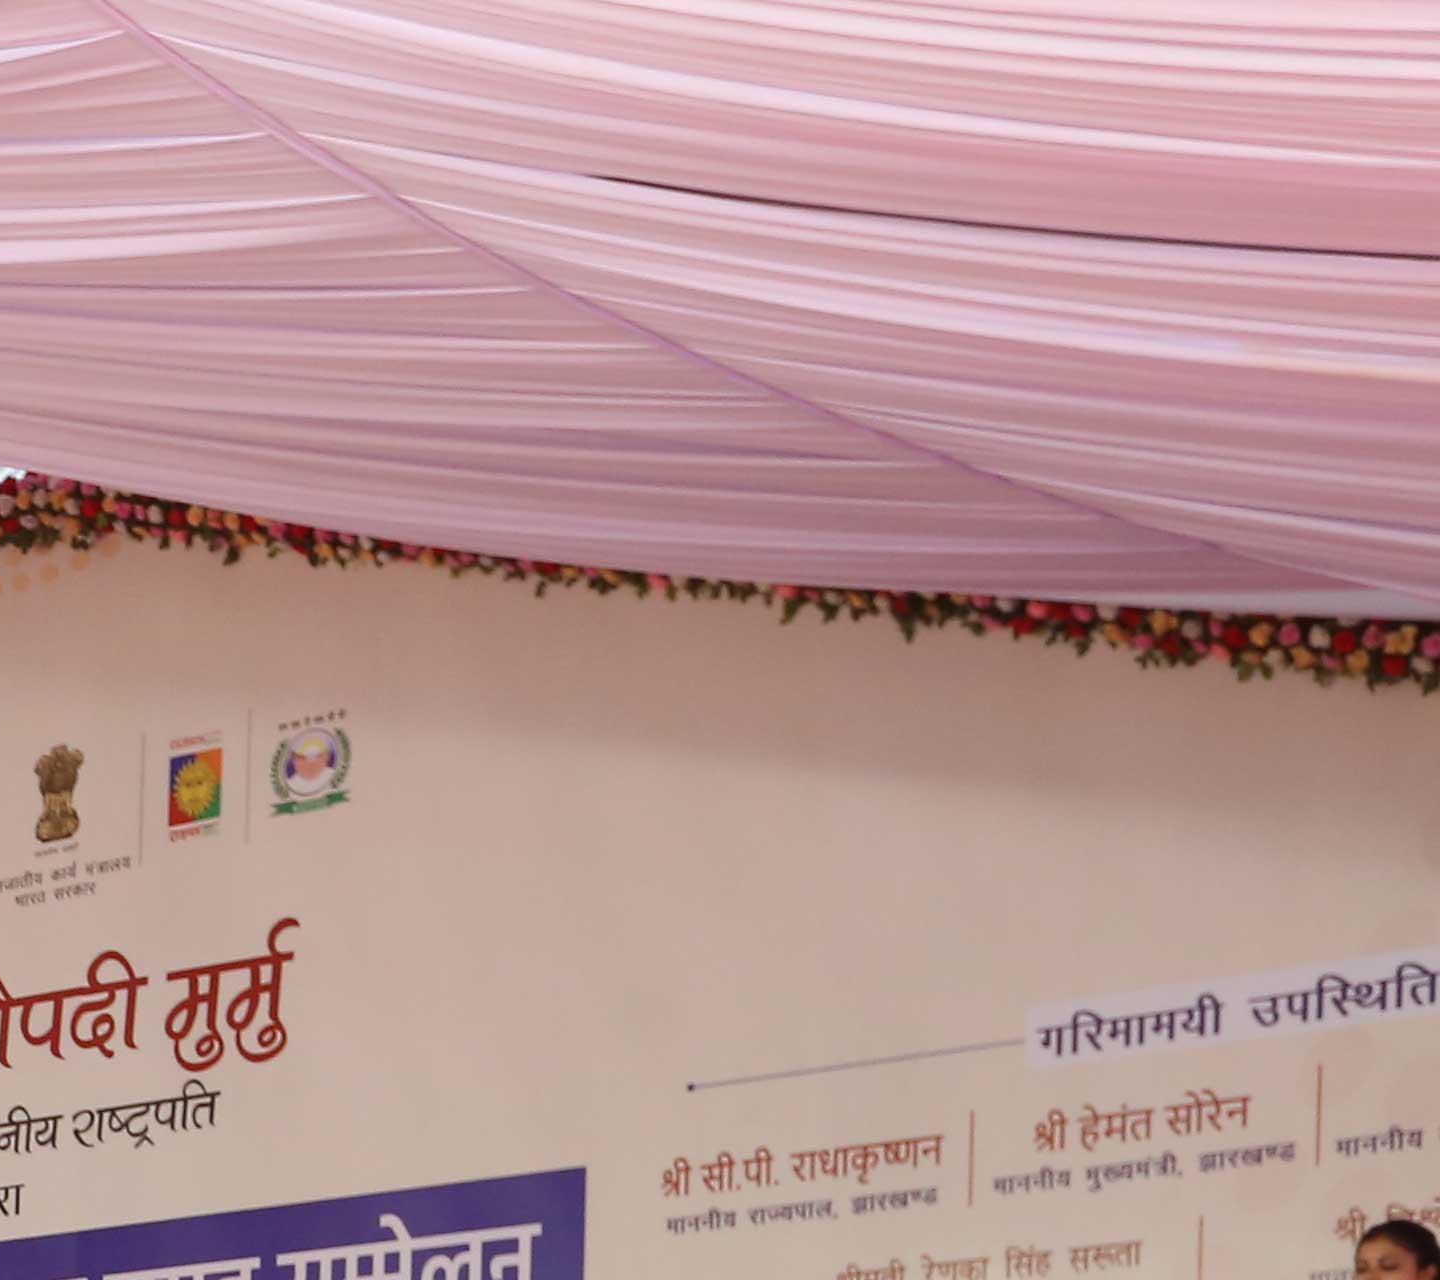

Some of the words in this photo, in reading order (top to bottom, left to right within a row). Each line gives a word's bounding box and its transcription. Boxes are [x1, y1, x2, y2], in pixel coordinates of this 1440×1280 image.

[14, 889, 47, 907] भारत
[53, 881, 97, 901] सरकार
[51, 861, 78, 883] कार्य
[85, 855, 132, 877] मंत्रालय
[164, 917, 301, 1073] मुर्मु
[1037, 992, 1224, 1058] गरिमामयी
[1250, 961, 1440, 1028] उपस्थिति
[72, 1079, 222, 1149] राष्ट्रपति
[1033, 1108, 1068, 1153] श्री
[1077, 1103, 1155, 1153] हेमंत
[1165, 1088, 1252, 1139] सोरेन
[661, 1156, 691, 1198] श्री
[790, 1134, 945, 1185] राधाकृष्णन
[993, 1166, 1071, 1196] माननीय
[1199, 1142, 1297, 1173] झारखण्ड
[1335, 1126, 1424, 1158] माननीय
[666, 1208, 737, 1236] माननीय
[851, 1186, 939, 1216] झारखण्ड
[1005, 1244, 1053, 1279] सिंह
